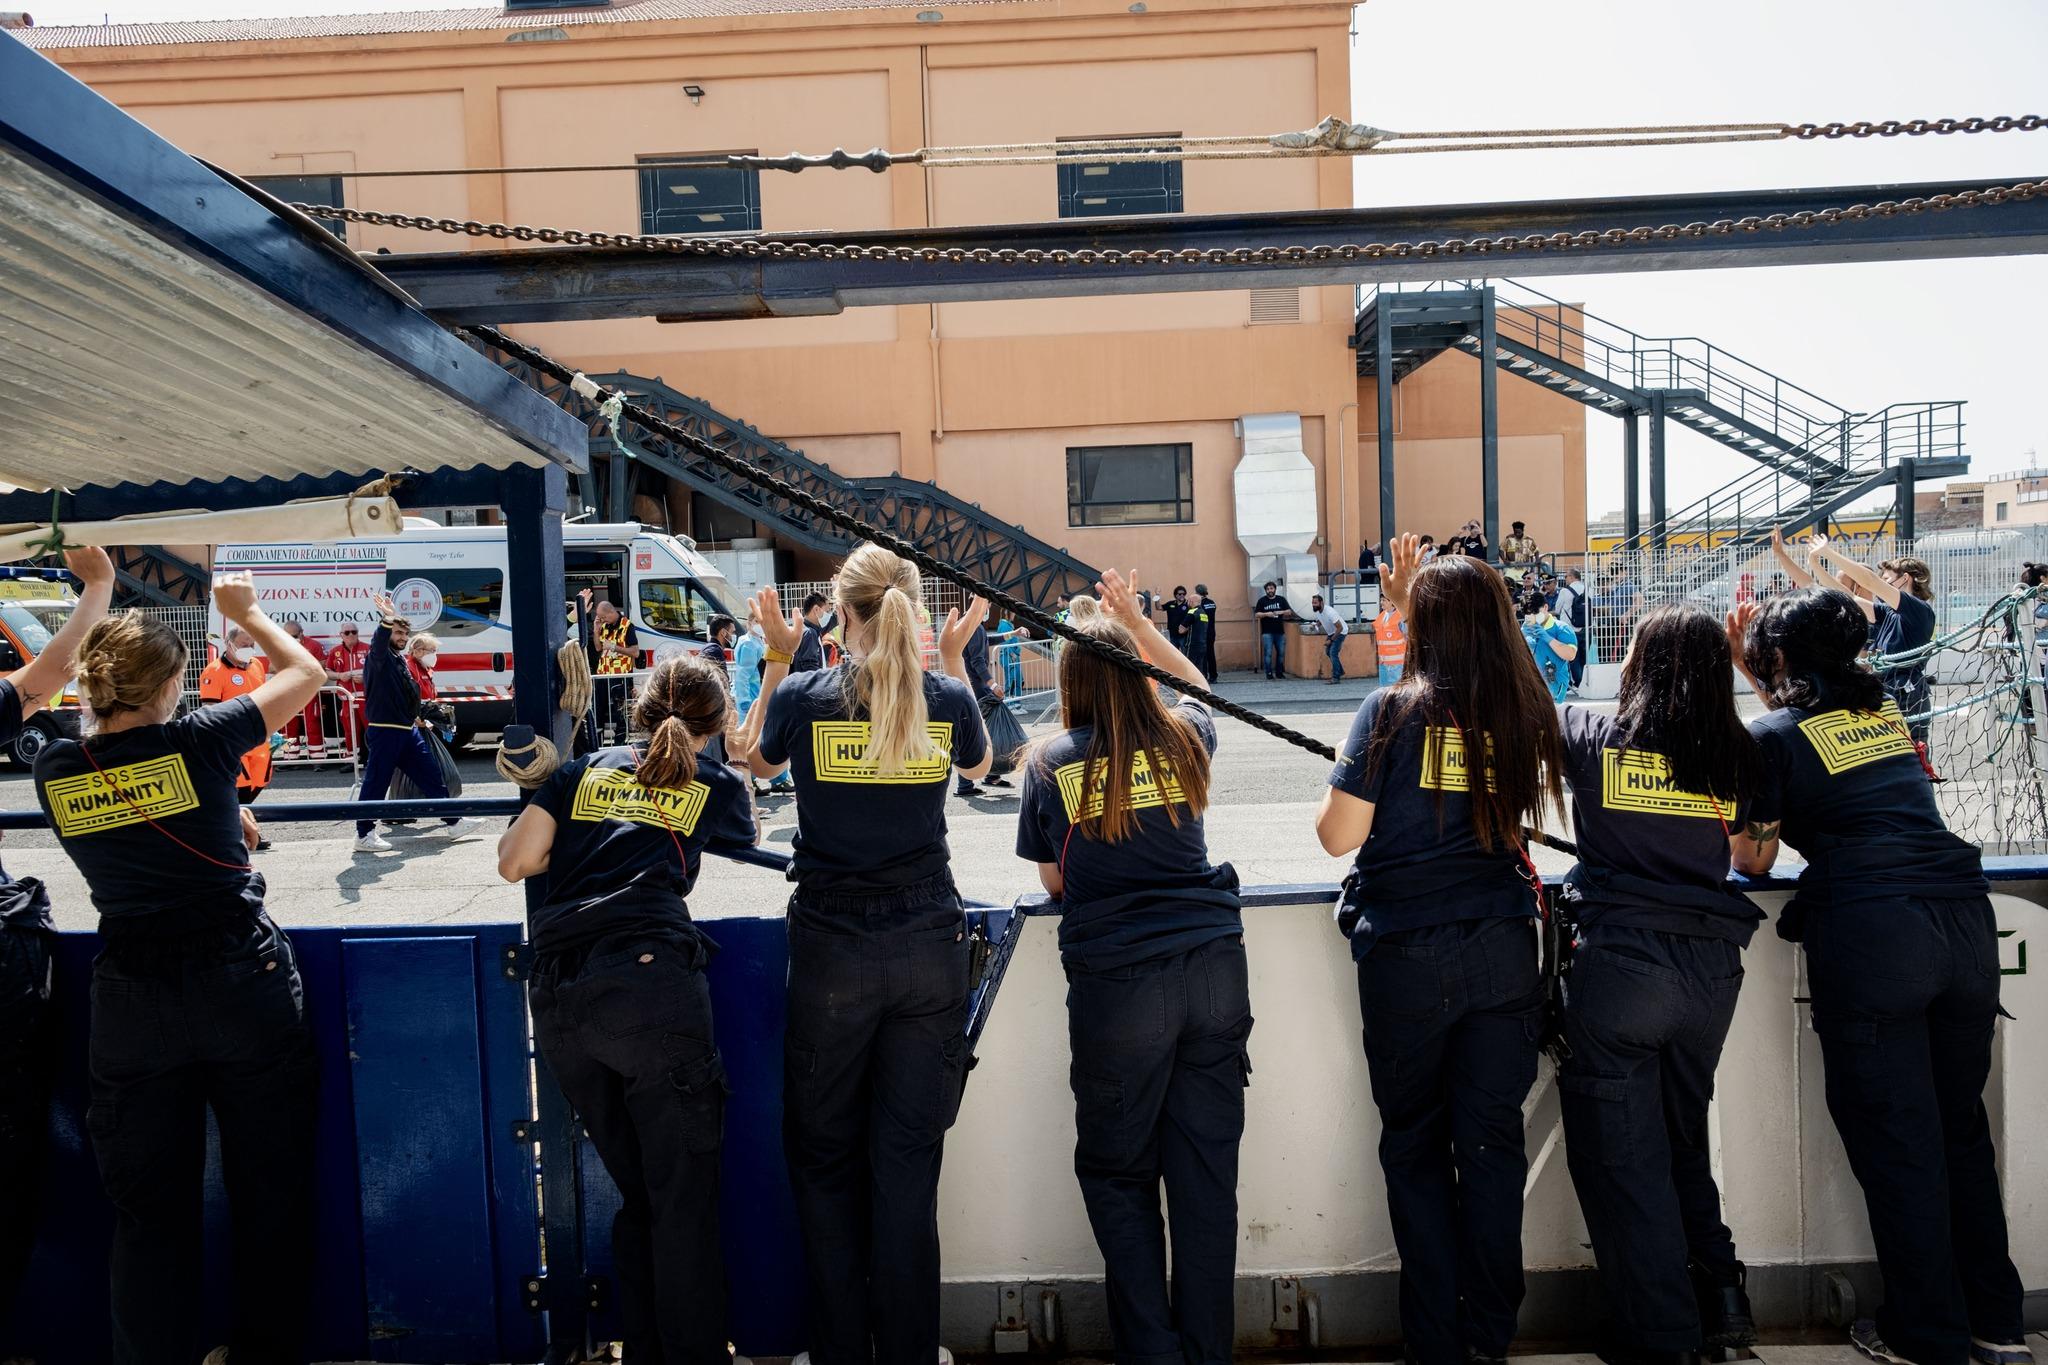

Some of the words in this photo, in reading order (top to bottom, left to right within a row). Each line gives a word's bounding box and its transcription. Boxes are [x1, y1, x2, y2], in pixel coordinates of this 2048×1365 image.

[227, 549, 299, 561] COORDINAMENTO
[300, 548, 347, 560] REGIONALE
[323, 611, 383, 622] TOSCAN
[92, 769, 130, 788] SOS
[68, 780, 164, 814] HUMANITY
[595, 785, 684, 810] HUMANITY
